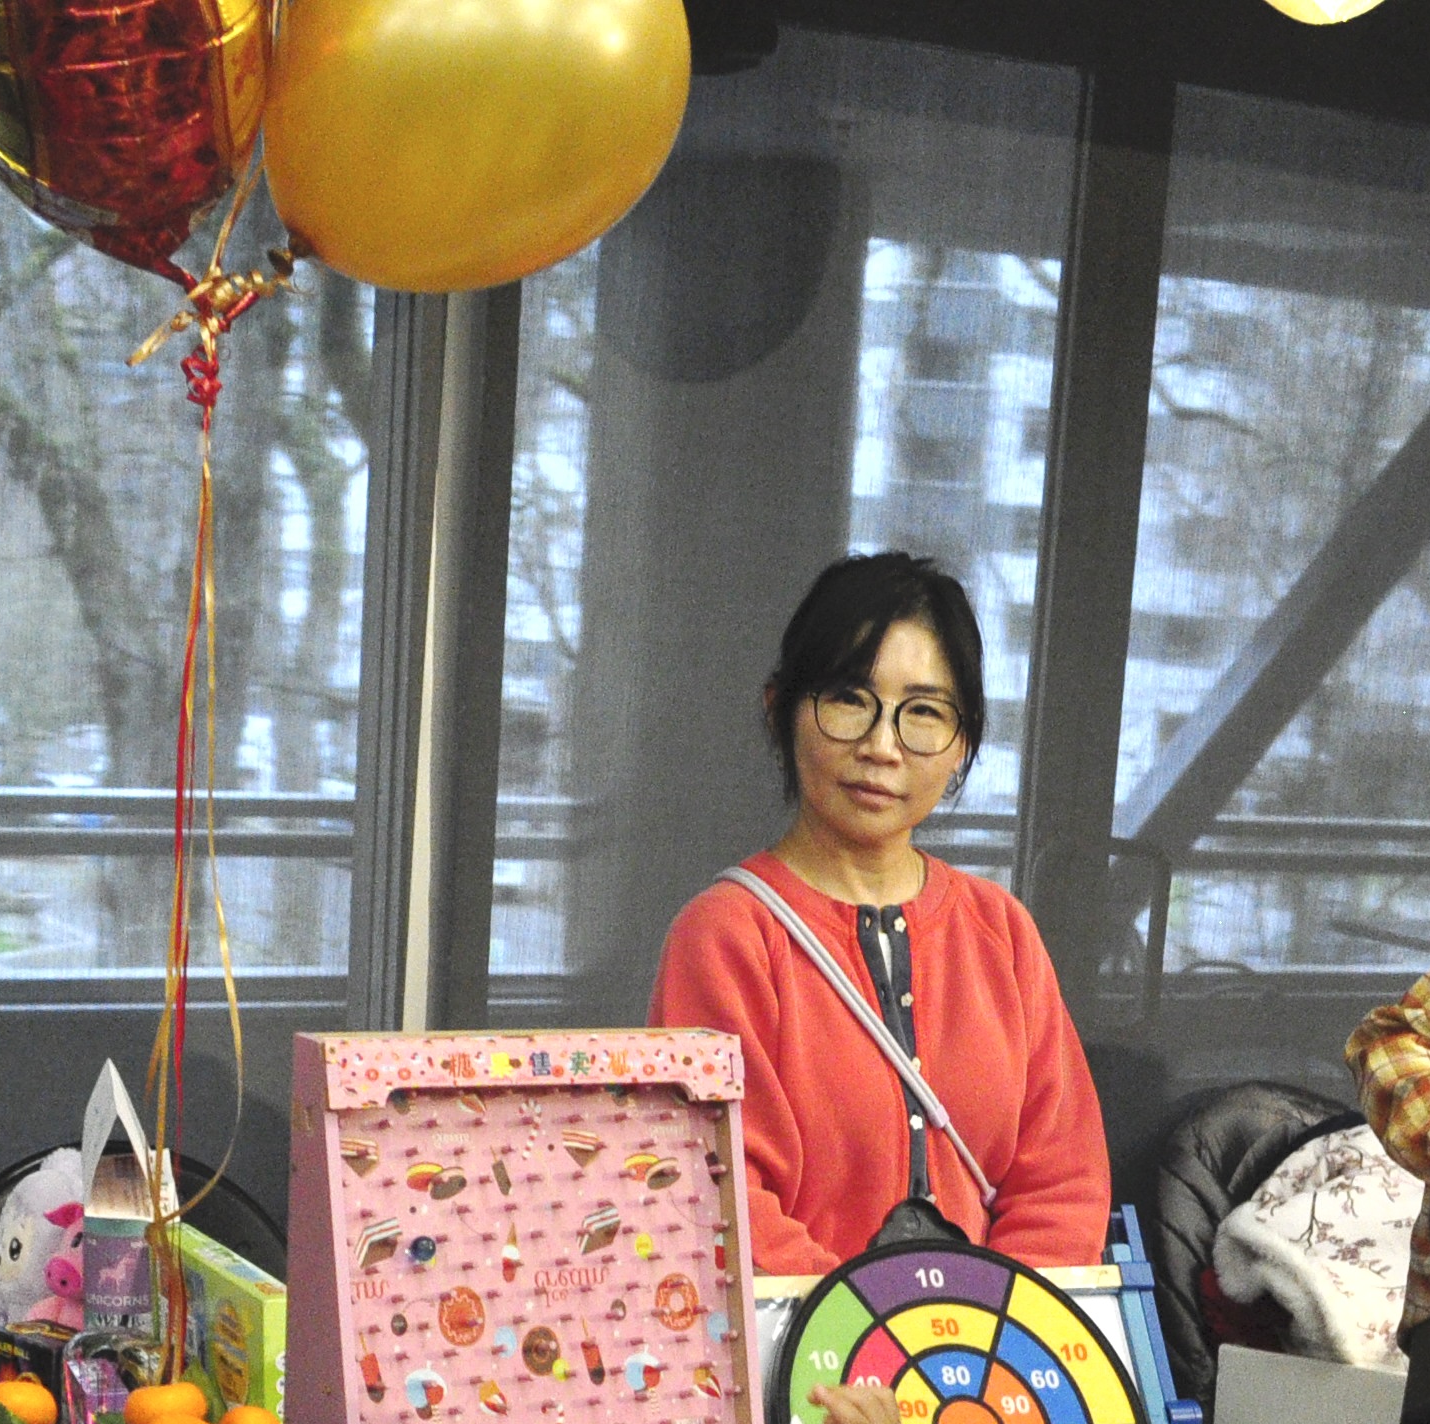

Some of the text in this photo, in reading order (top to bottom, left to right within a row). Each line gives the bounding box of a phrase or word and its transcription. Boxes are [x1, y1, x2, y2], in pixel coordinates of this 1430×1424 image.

[915, 1269, 944, 1289] 10
[931, 1318, 959, 1337] 50
[809, 1350, 839, 1370] 10
[1060, 1343, 1087, 1362] 10
[941, 1366, 970, 1386] 80
[1030, 1370, 1060, 1389] 60
[899, 1400, 928, 1418] 90
[1001, 1395, 1030, 1415] 90
